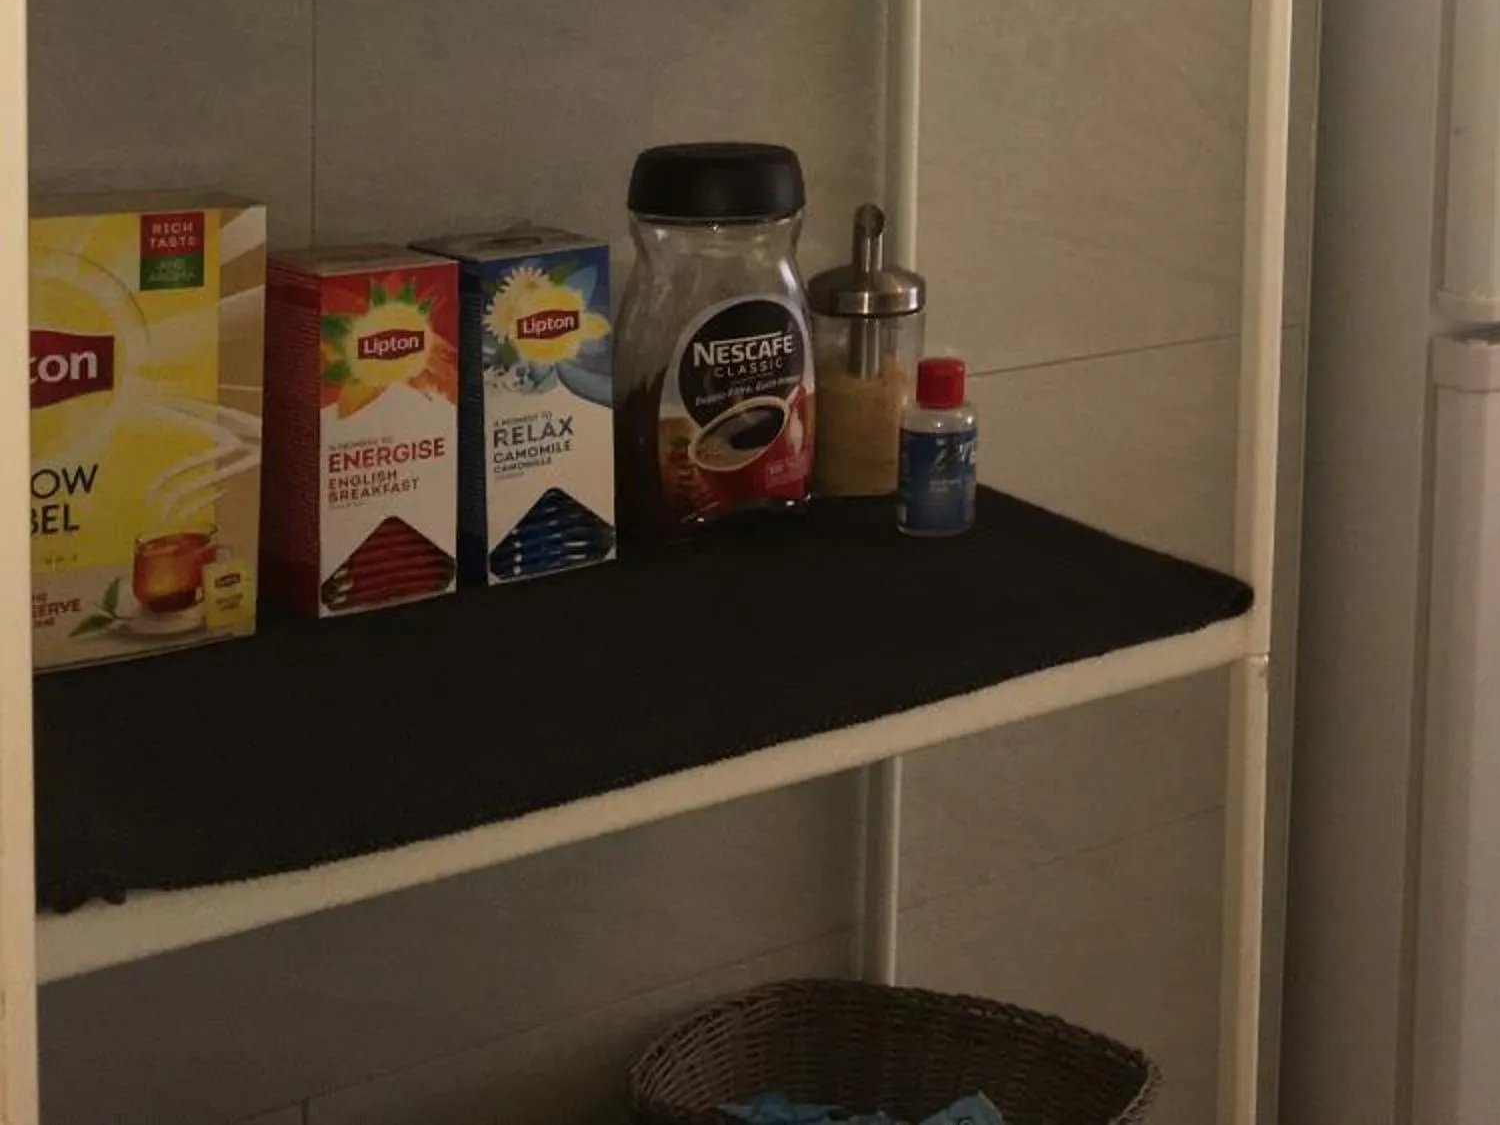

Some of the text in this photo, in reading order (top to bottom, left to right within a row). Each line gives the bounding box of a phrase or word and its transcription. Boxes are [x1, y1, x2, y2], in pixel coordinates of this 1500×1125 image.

[151, 221, 194, 235] RICH
[149, 236, 196, 249] TASTE
[522, 315, 575, 336] Lipton
[363, 334, 420, 356] Lipton
[714, 357, 784, 378] CLASSIC
[493, 415, 575, 449] RELAX
[328, 436, 446, 474] ENERGISE
[493, 439, 572, 464] CAMOMILE
[328, 469, 398, 490] ENGLISH
[328, 477, 420, 504] BREAKFAST
